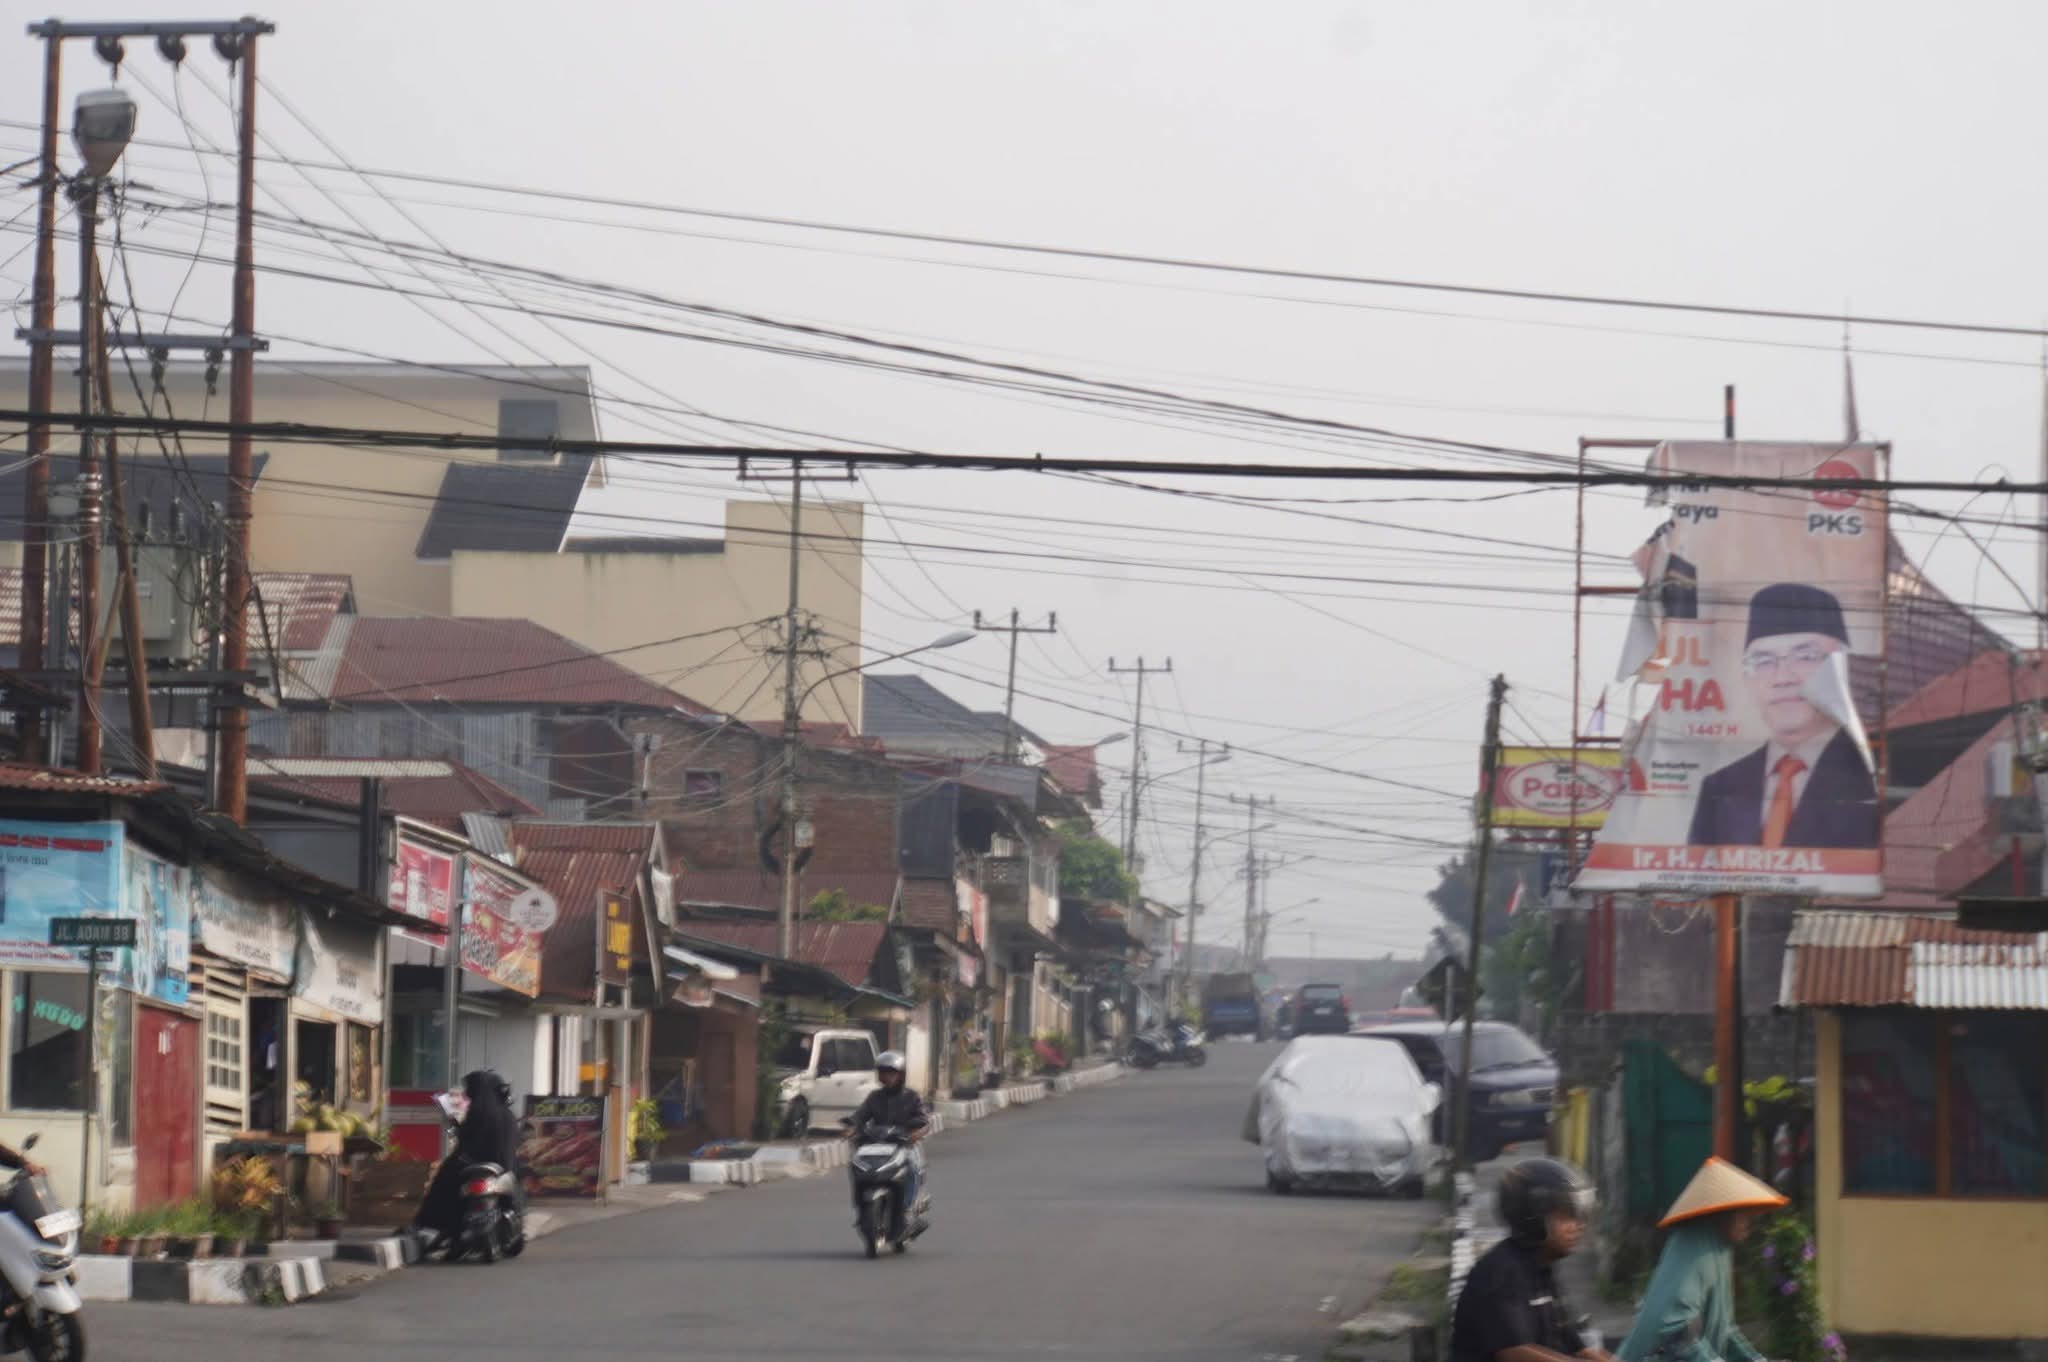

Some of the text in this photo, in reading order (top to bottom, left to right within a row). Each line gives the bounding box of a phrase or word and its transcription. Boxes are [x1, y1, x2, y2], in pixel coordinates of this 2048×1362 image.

[1809, 513, 1862, 535] PKS
[1660, 676, 1727, 713] HA
[1633, 847, 1825, 872] Ir. H. AMRIZAL
[77, 925, 110, 941] ADAM
